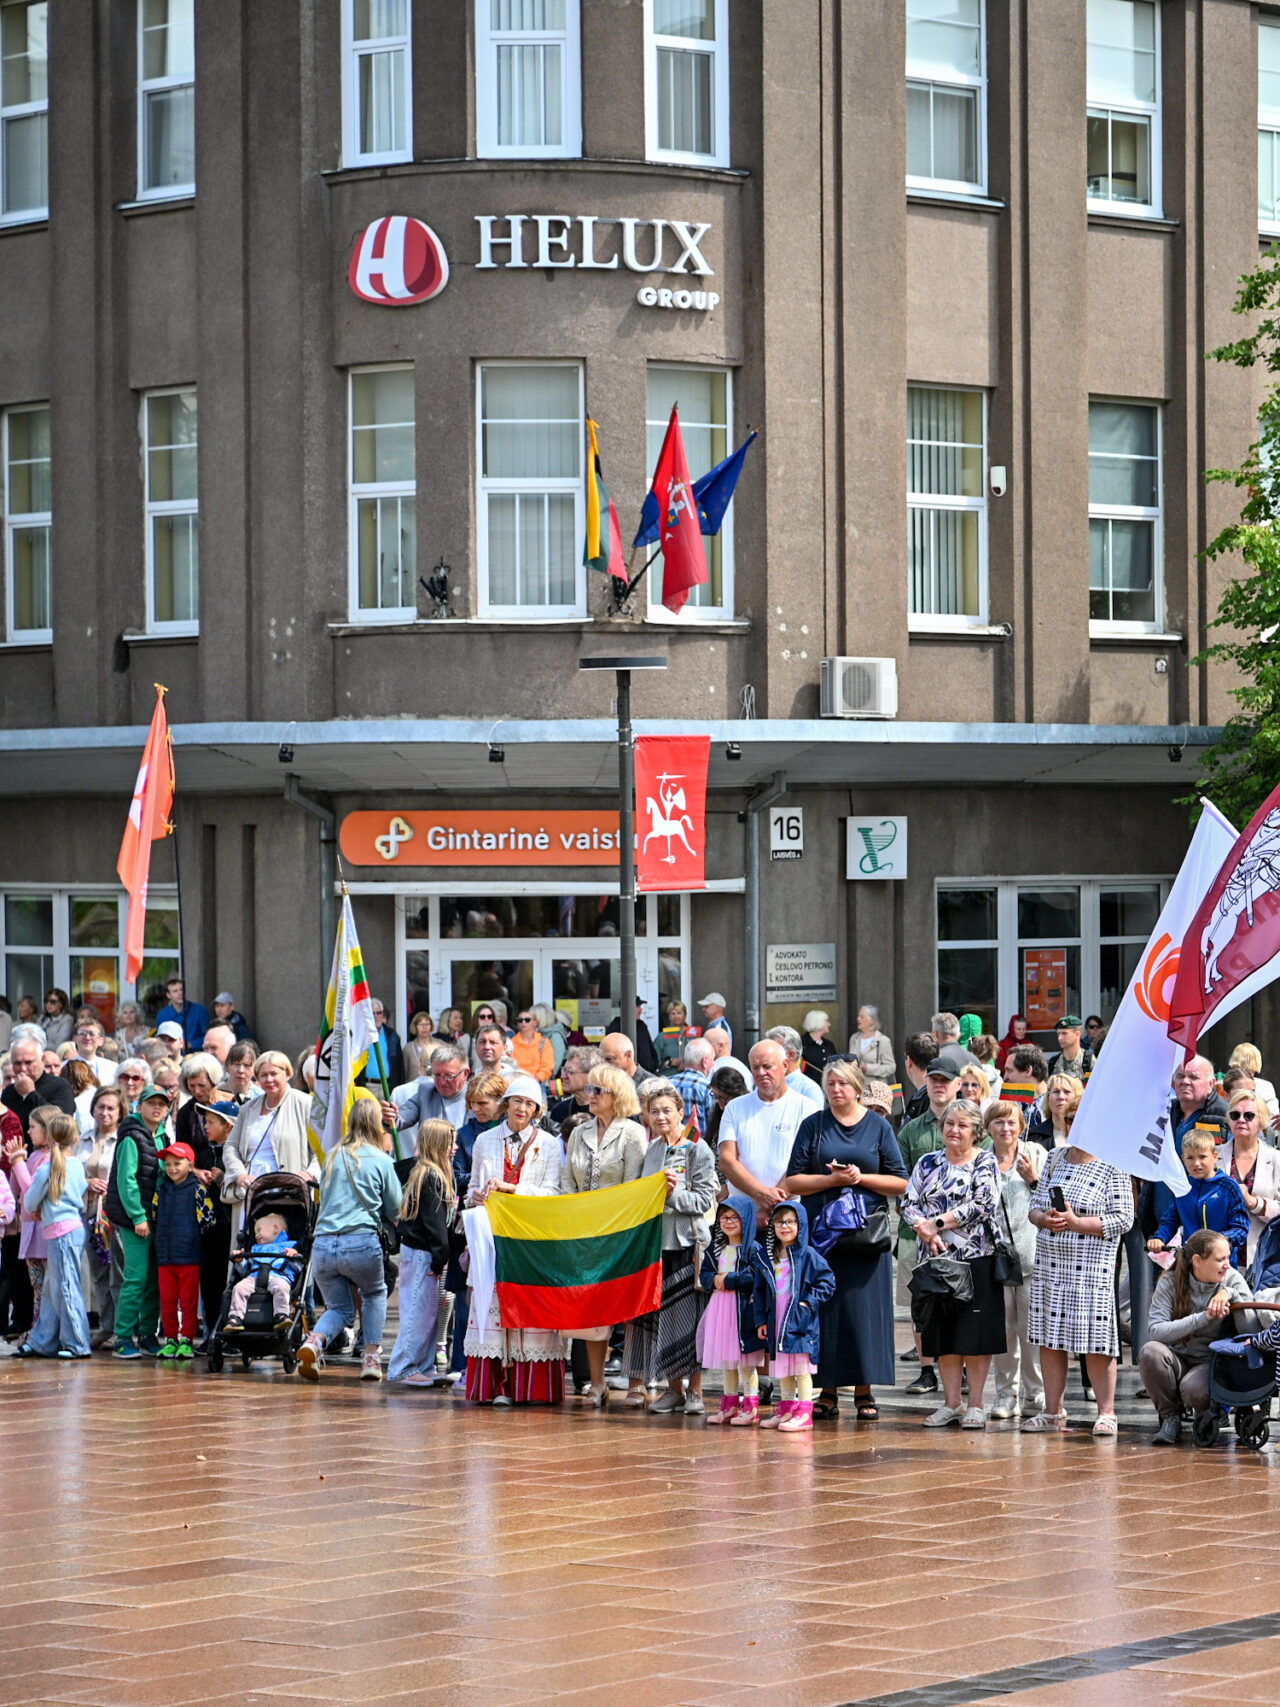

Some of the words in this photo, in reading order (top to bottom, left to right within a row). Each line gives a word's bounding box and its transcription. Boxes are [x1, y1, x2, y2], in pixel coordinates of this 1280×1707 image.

[474, 215, 714, 275] HELUX
[637, 287, 720, 311] GROUP
[427, 826, 550, 850] Gintarinė
[560, 827, 638, 850] vaist
[773, 816, 801, 840] 16
[775, 951, 807, 959] ADVOKATO
[775, 961, 803, 971] ČESLOVO
[804, 961, 834, 970] PETRONIO
[775, 974, 804, 982] KONTORA
